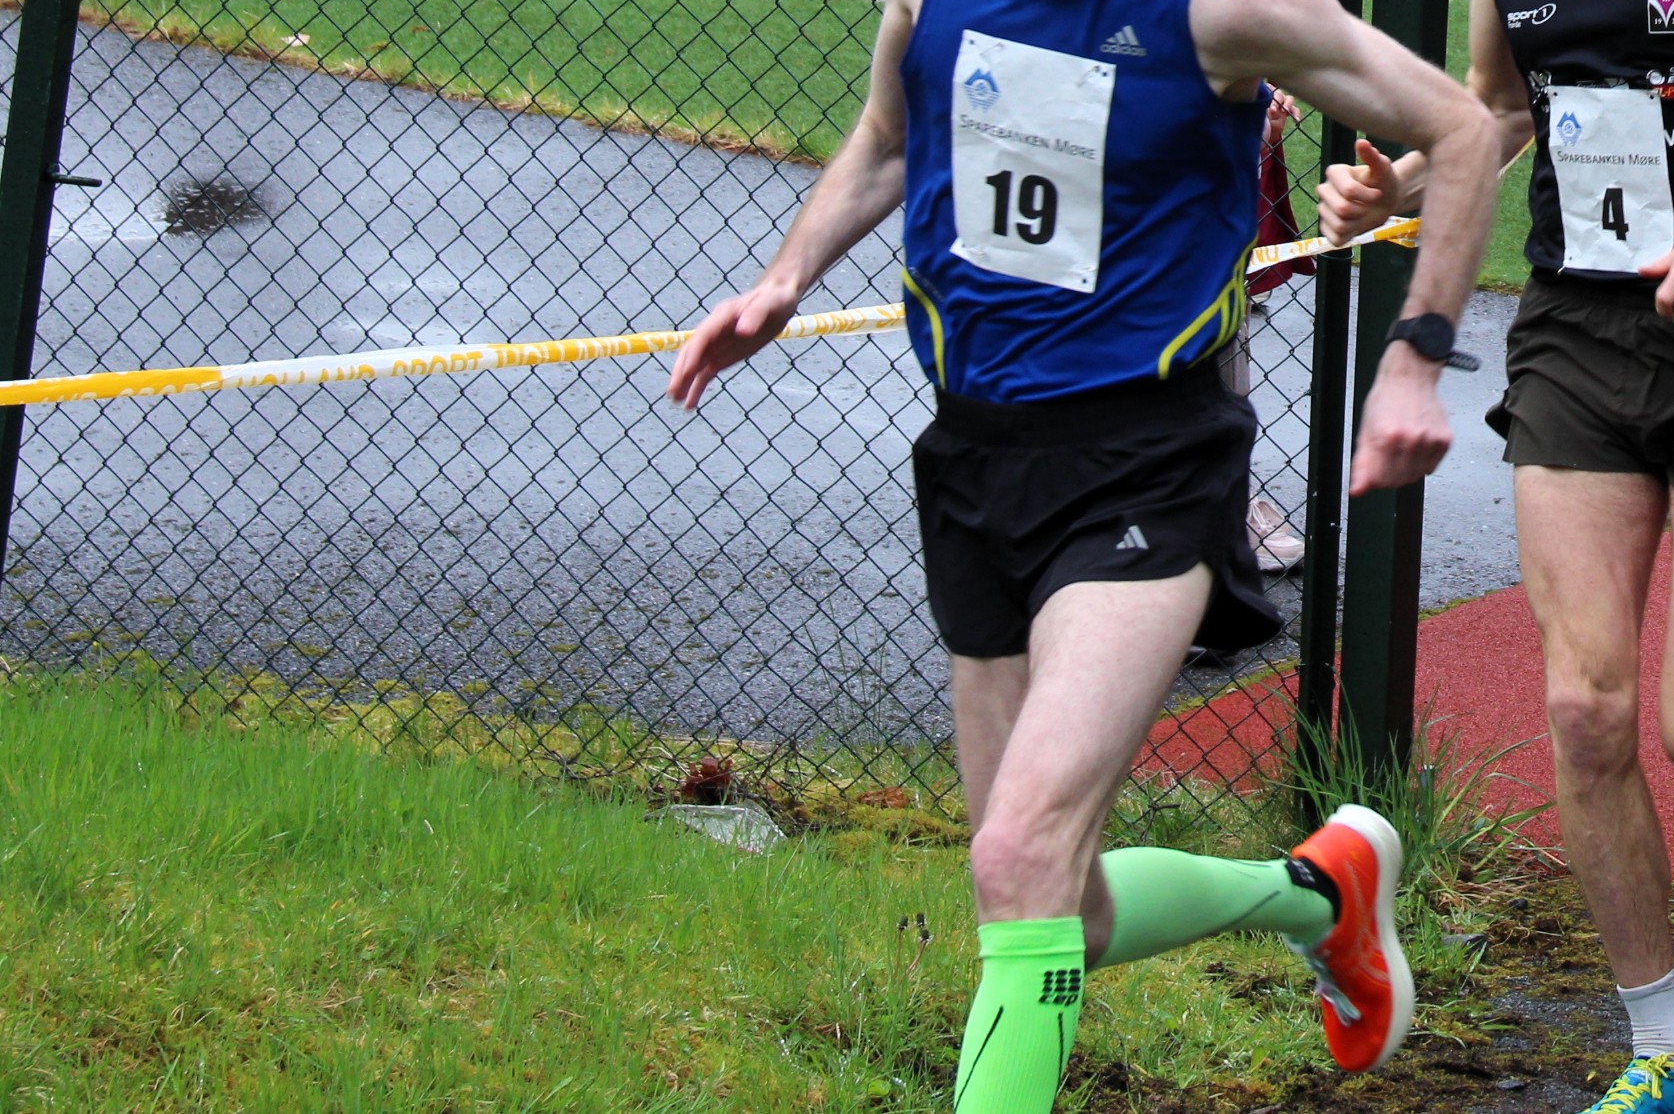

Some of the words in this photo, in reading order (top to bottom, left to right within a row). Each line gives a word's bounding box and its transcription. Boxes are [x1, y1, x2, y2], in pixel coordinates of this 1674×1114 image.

[1100, 43, 1148, 57] adidas
[985, 169, 1058, 246] 19
[1602, 187, 1630, 242] 4
